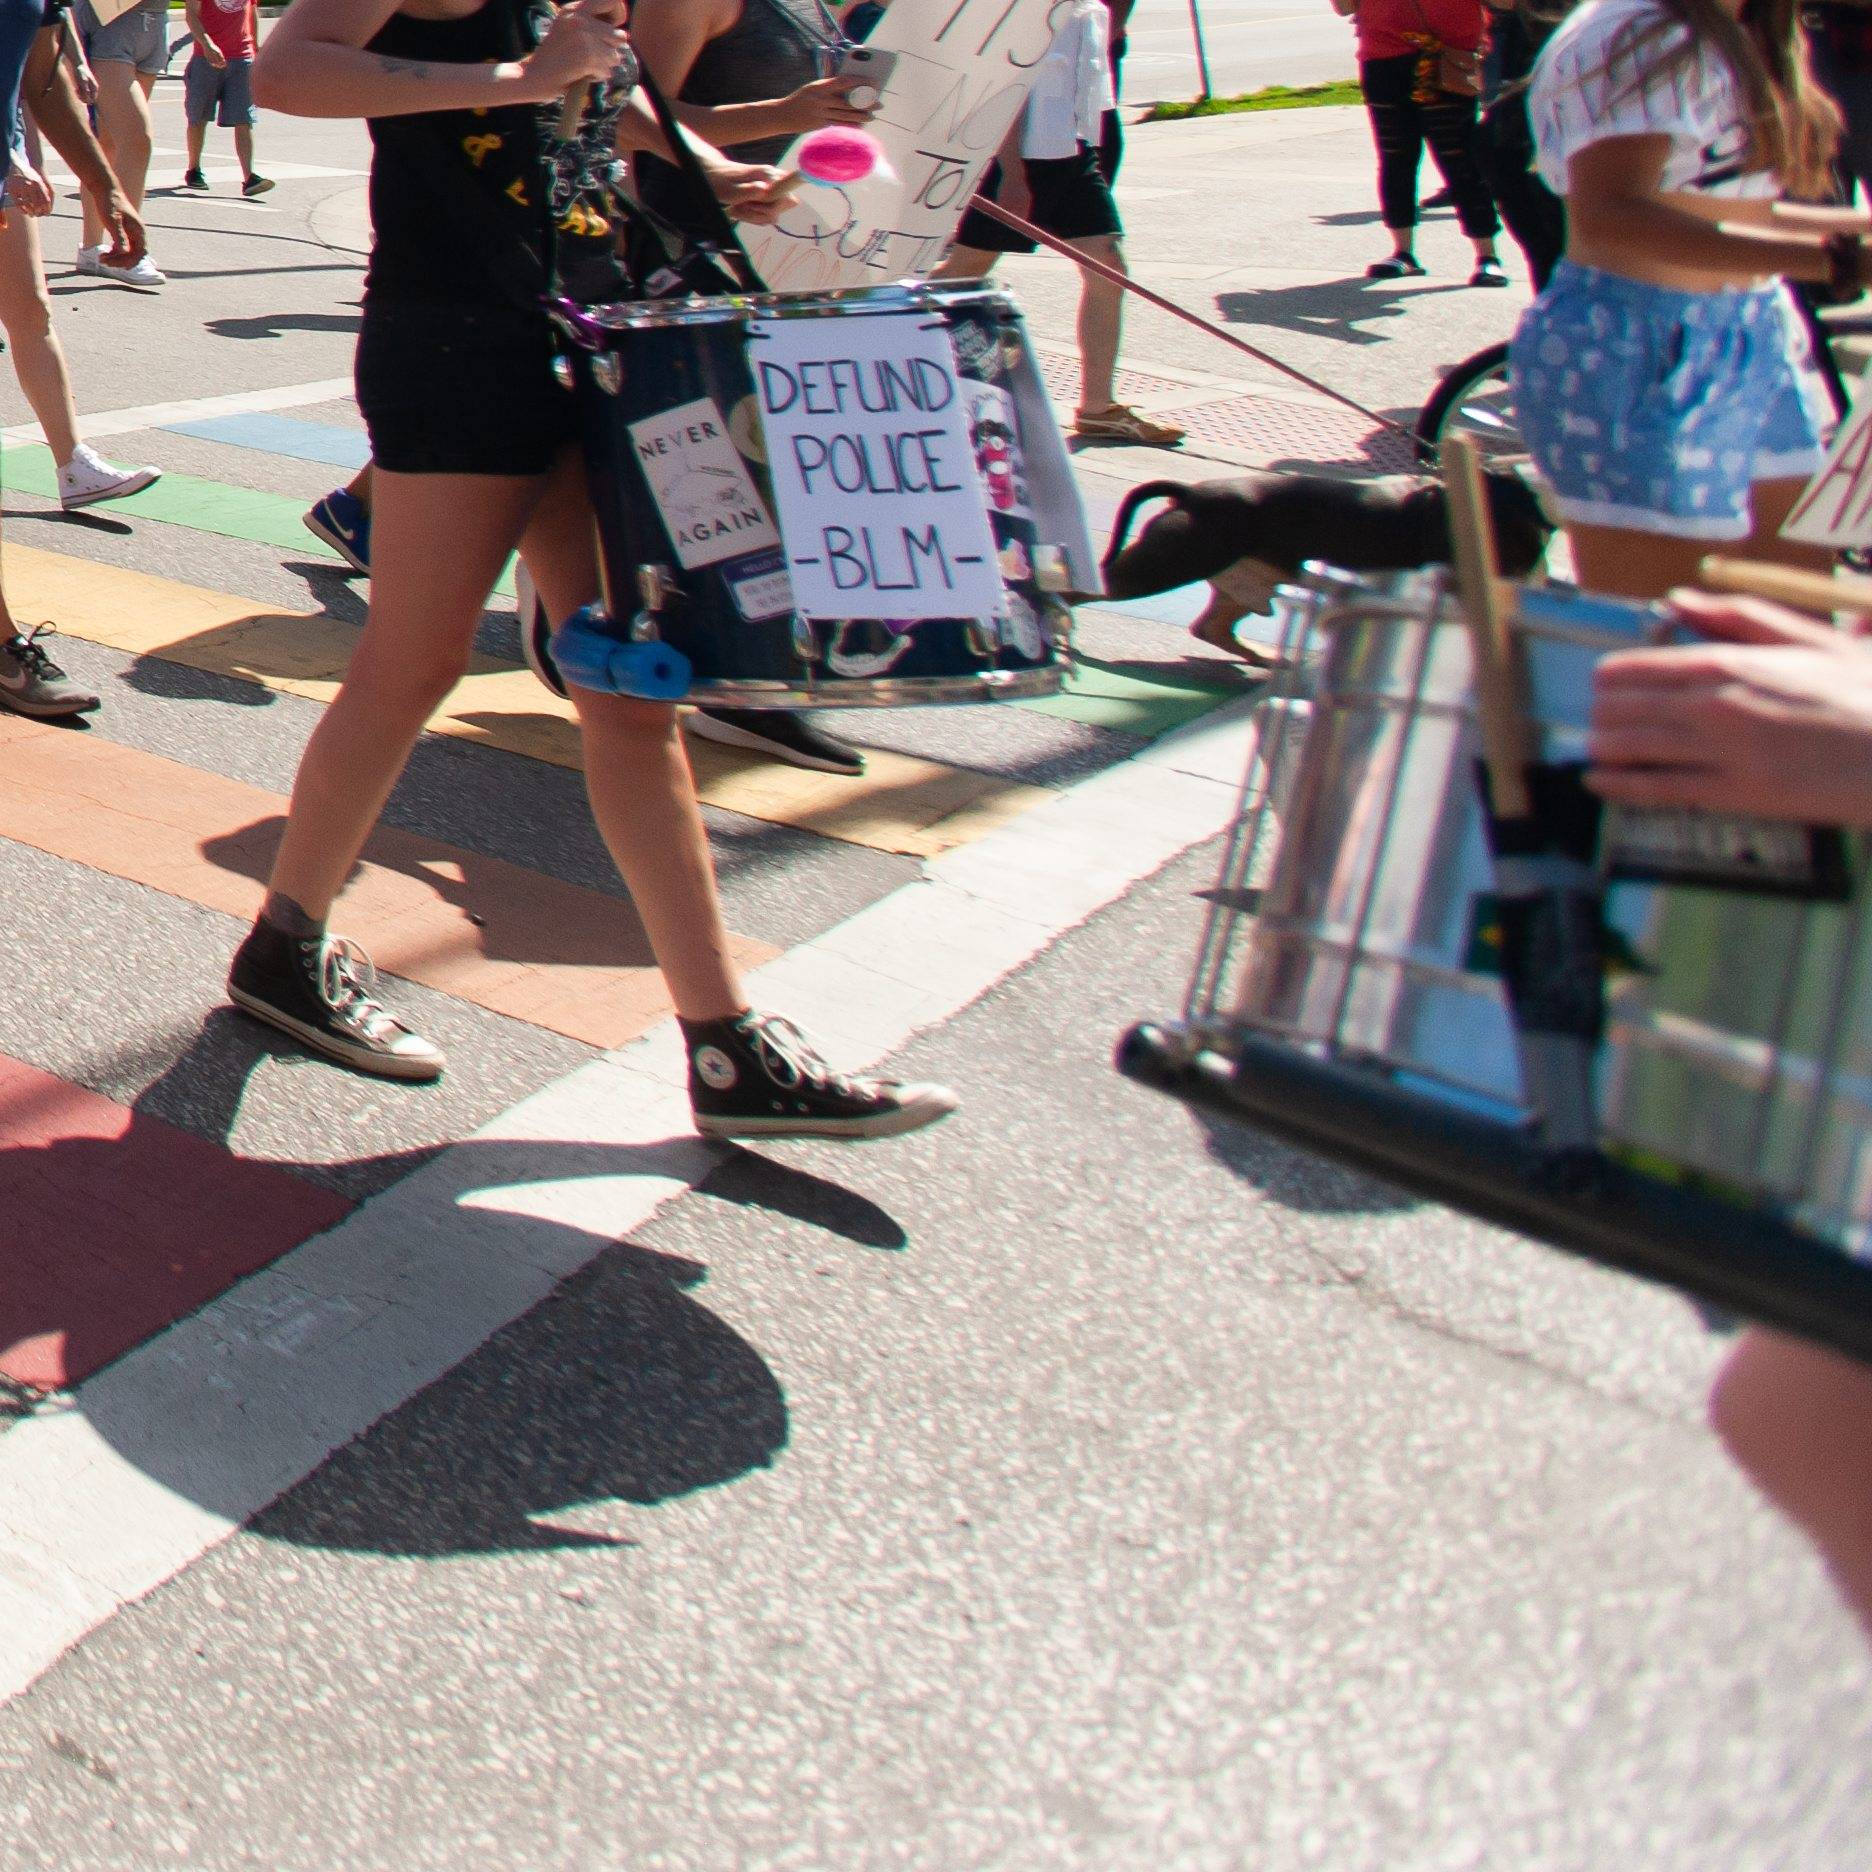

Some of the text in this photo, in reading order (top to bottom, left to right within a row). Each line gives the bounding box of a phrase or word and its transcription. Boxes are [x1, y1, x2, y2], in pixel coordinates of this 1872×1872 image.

[758, 358, 954, 414] DEFUND
[638, 421, 721, 461] NEVER
[795, 429, 961, 495] POLICE
[678, 507, 765, 547] AGAIN
